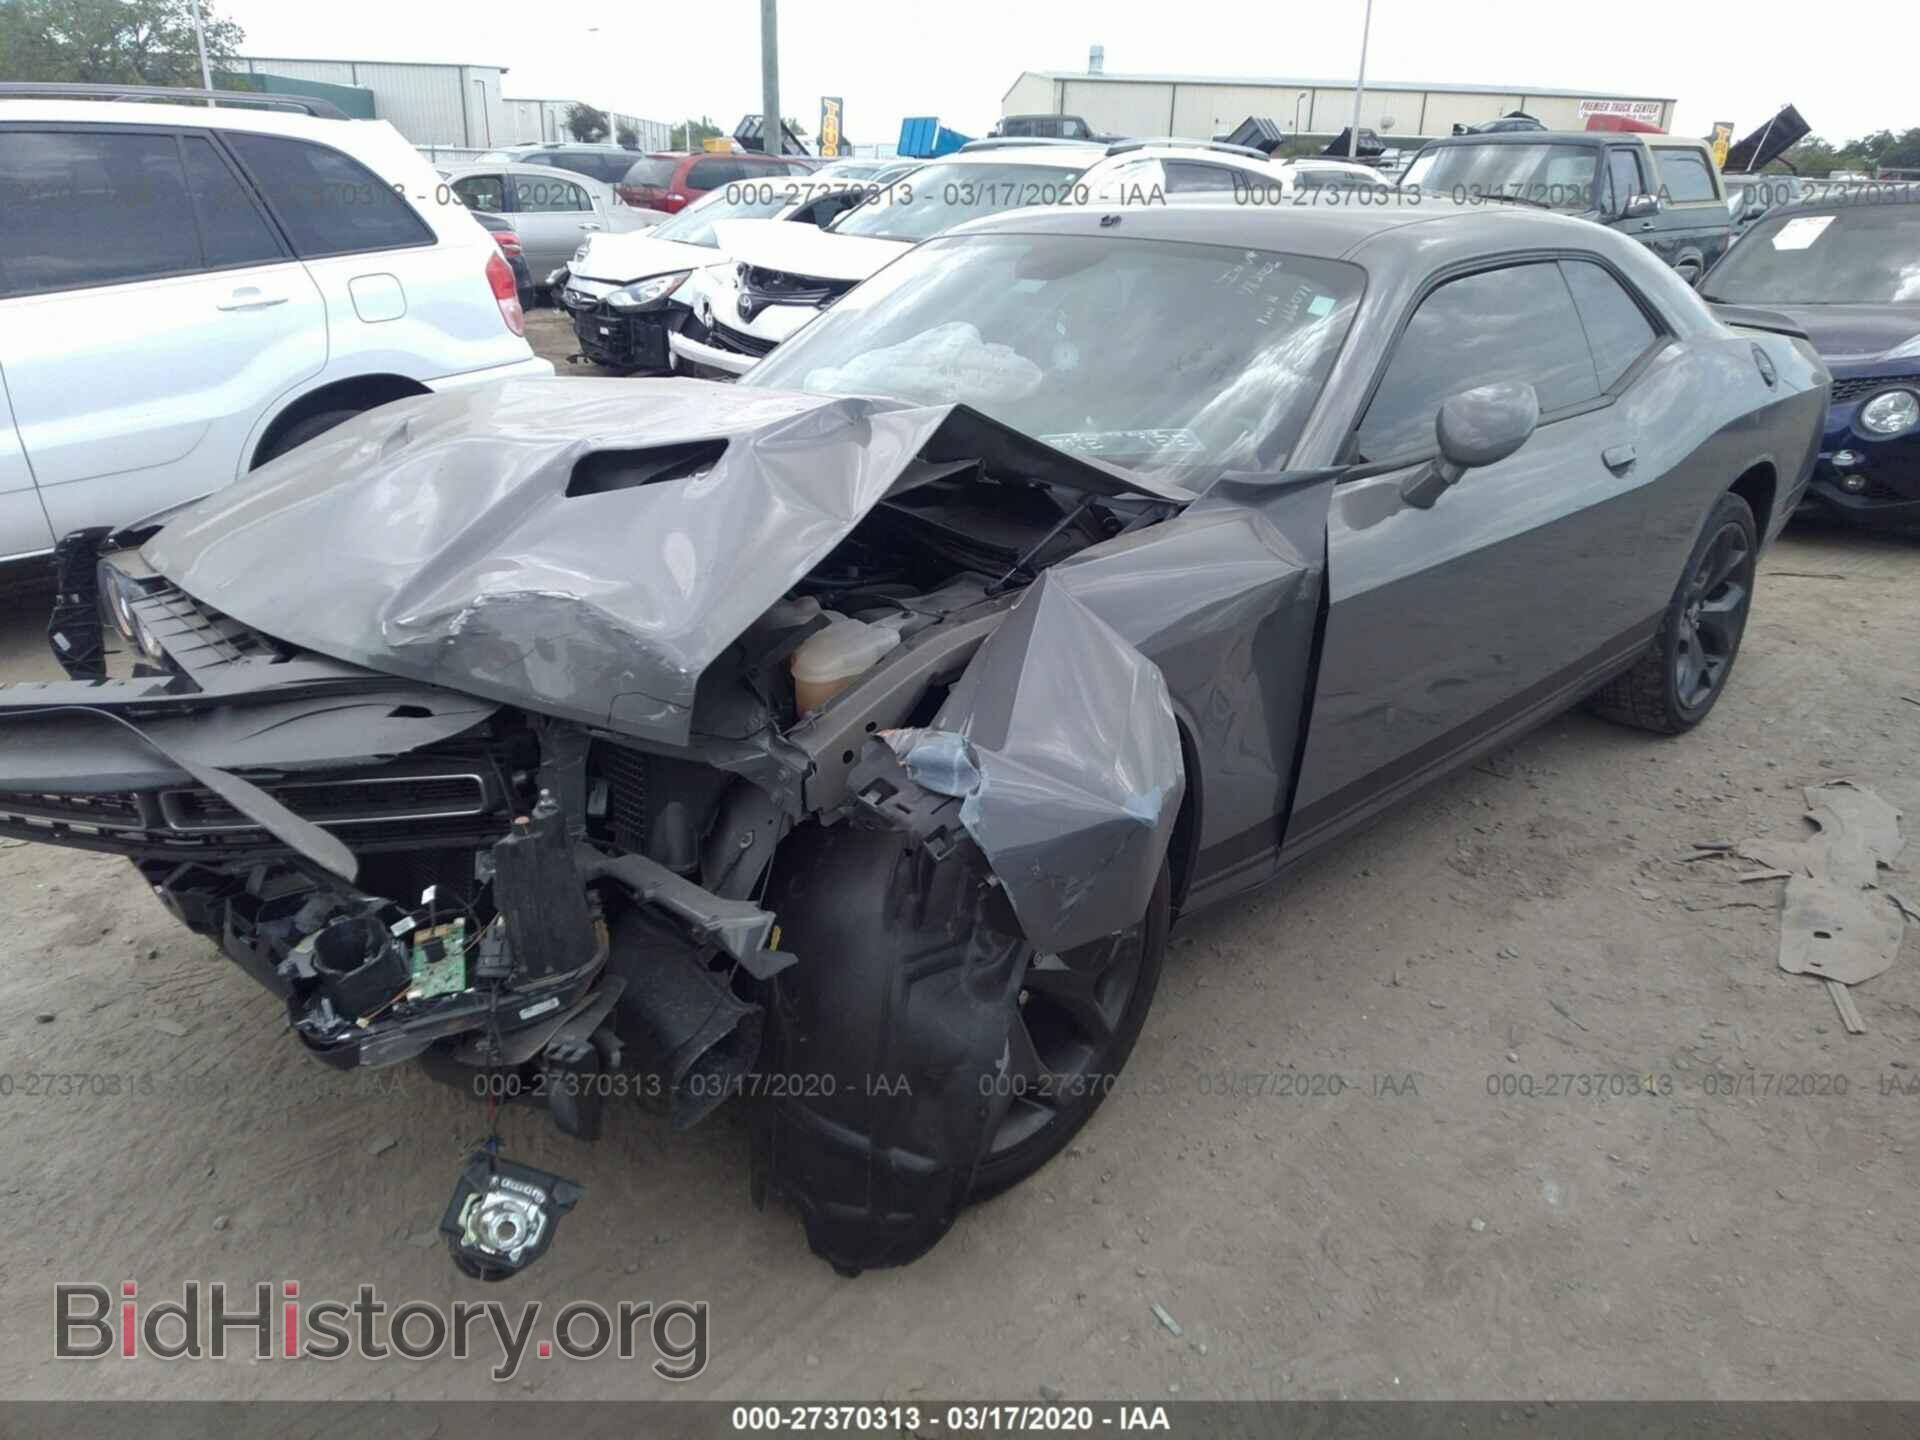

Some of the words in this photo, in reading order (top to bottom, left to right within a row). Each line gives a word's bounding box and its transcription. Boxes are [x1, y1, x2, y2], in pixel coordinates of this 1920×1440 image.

[1582, 102, 1610, 112] PREMIER
[1611, 102, 1633, 112] TRUCK
[1634, 103, 1660, 113] CENTER
